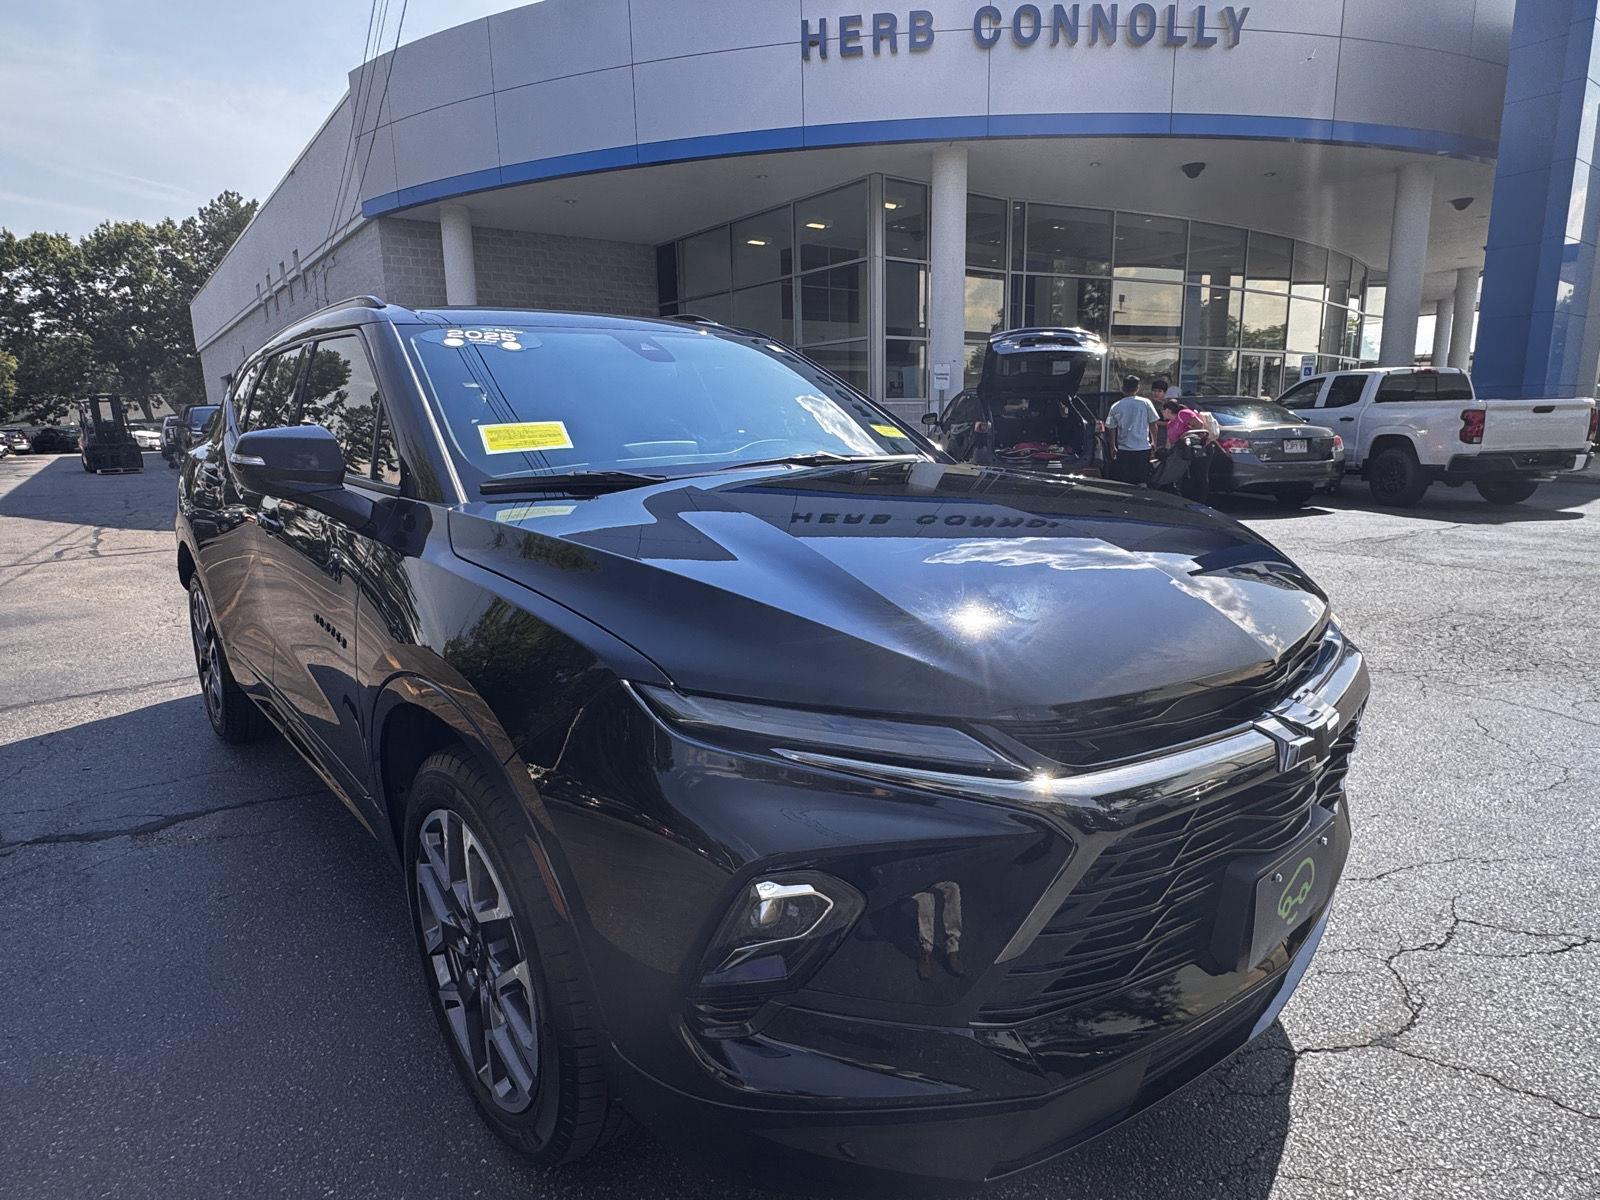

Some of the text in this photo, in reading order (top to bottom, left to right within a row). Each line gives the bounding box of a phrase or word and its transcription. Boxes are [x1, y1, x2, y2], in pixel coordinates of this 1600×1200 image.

[801, 3, 1250, 60] HERB CONNOLLY
[447, 329, 517, 341] 2025
